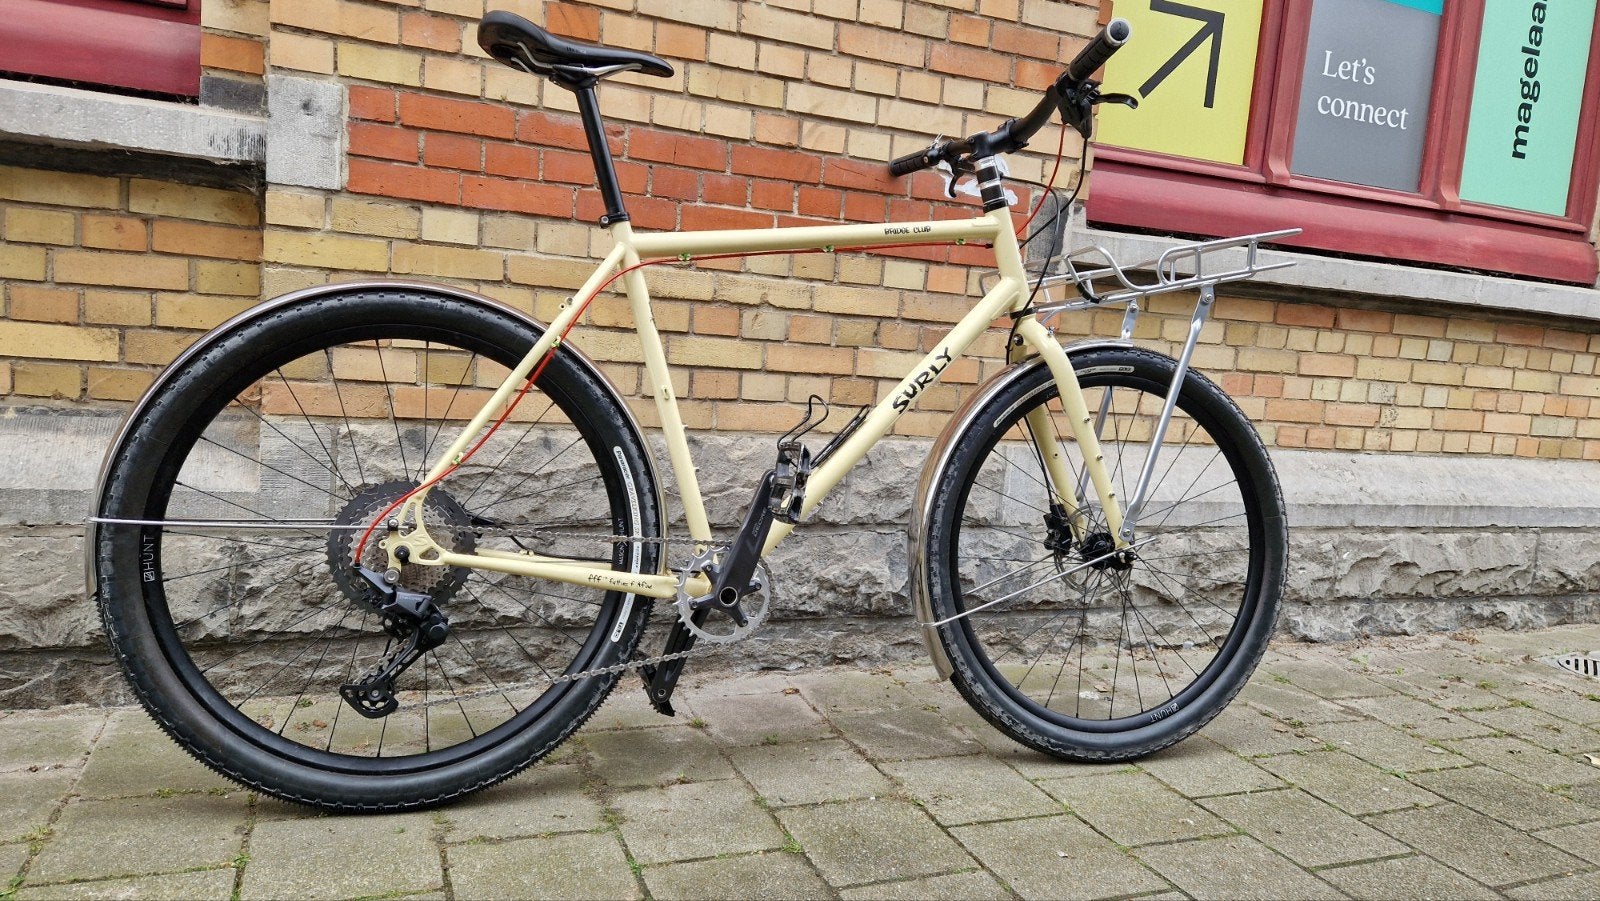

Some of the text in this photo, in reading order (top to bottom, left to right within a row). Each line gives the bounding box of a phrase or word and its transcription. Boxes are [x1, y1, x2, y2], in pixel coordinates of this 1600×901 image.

[1322, 50, 1376, 85] Let's
[1511, 0, 1550, 160] magelaa
[1317, 95, 1409, 130] connect
[913, 226, 931, 234] CLUB
[892, 346, 952, 415] SURLY
[143, 534, 155, 571] HUNT
[1151, 706, 1173, 721] HUNT
